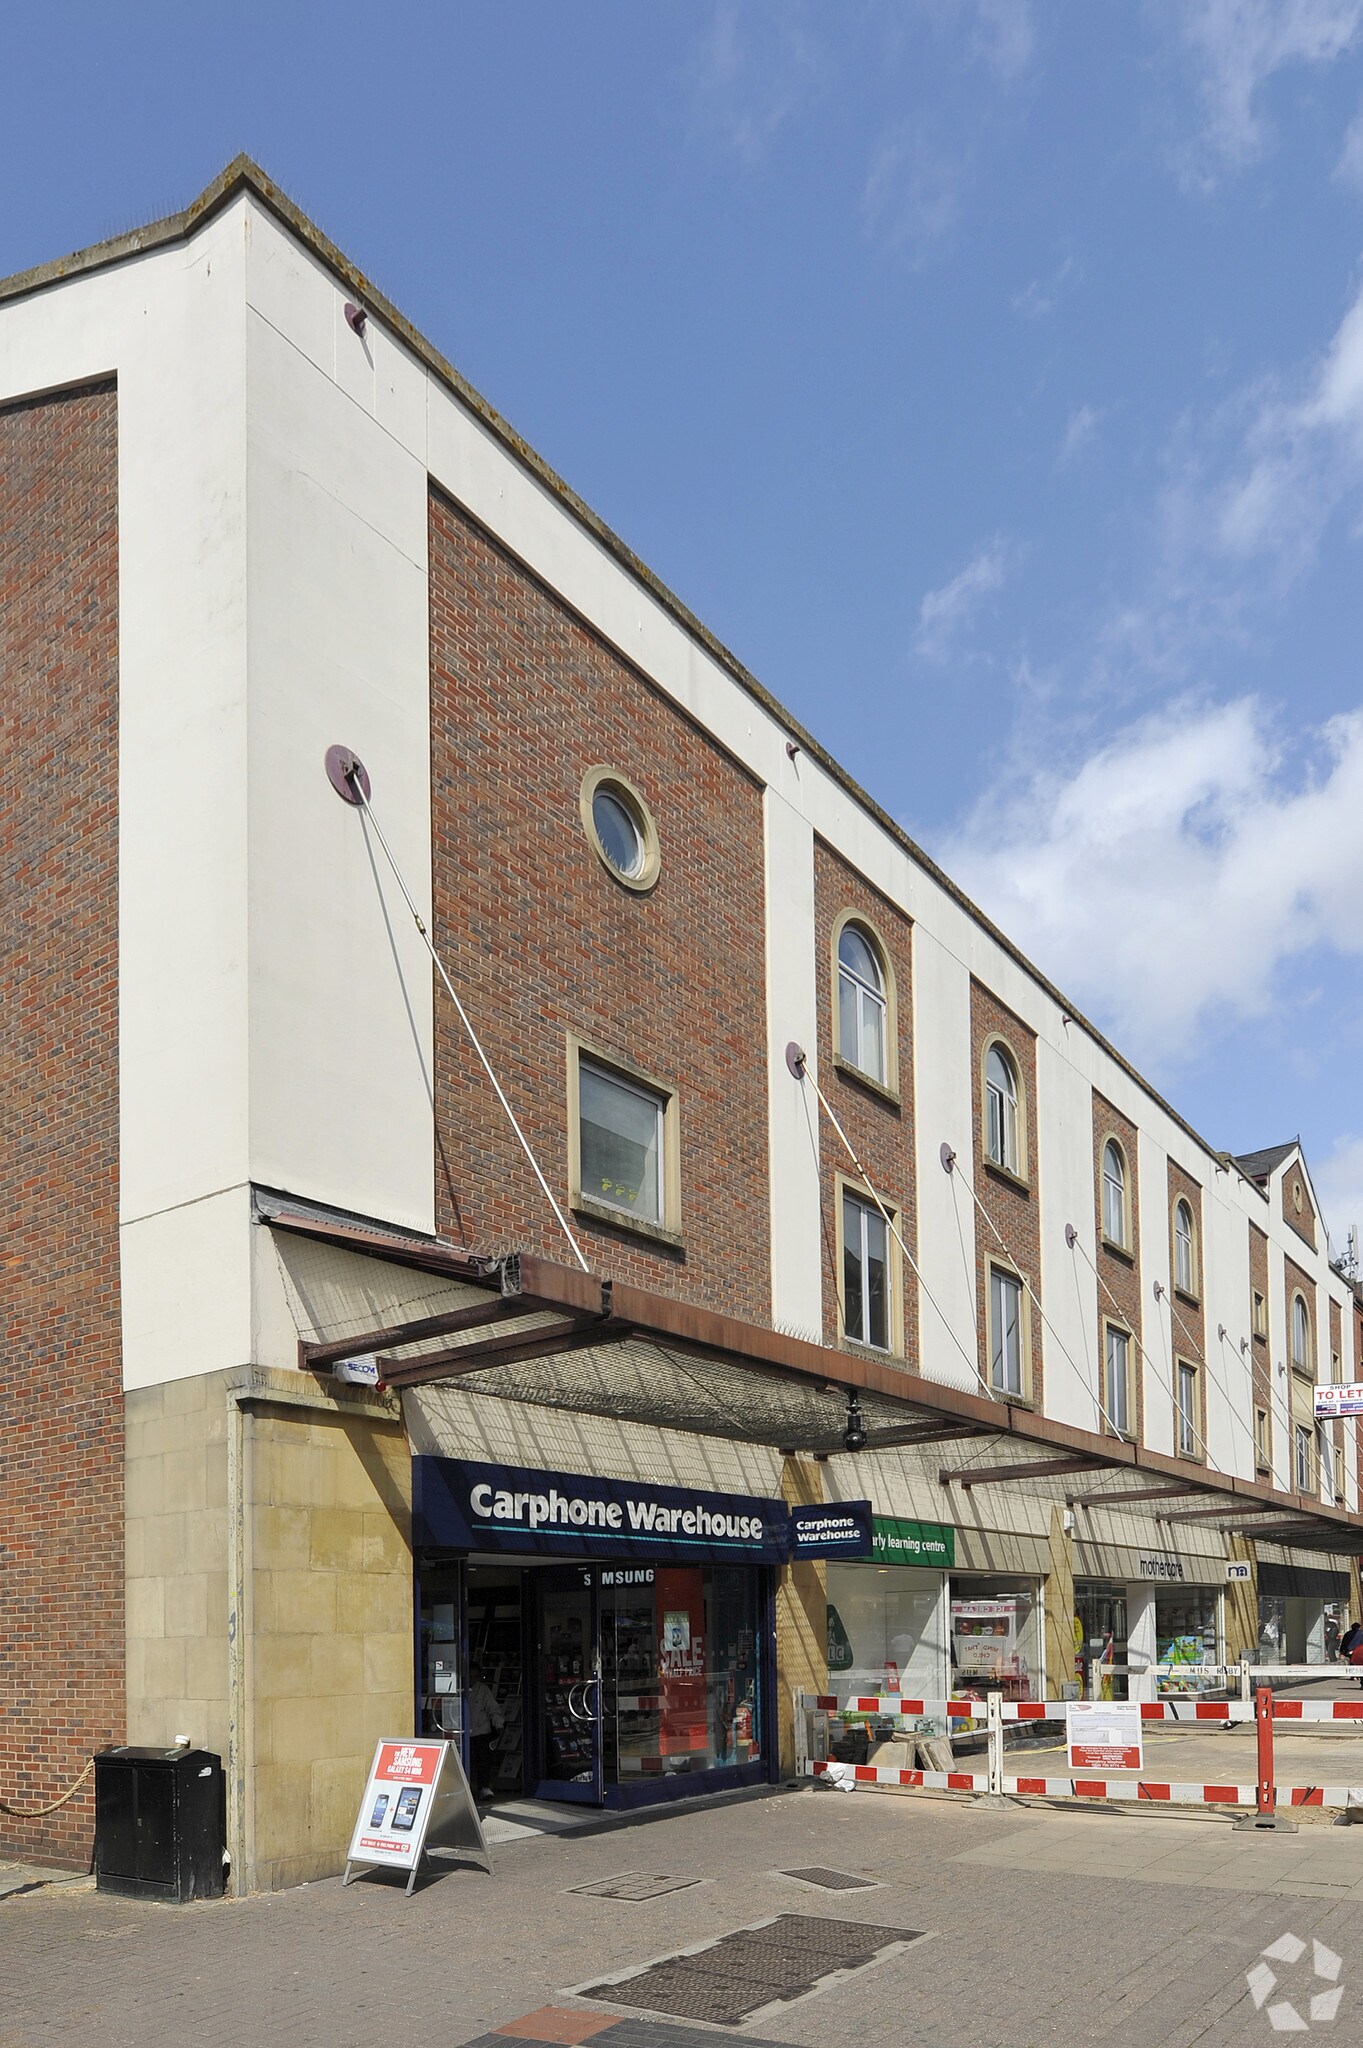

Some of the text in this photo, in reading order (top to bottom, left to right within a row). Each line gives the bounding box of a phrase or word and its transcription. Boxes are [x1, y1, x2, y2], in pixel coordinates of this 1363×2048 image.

[347, 1363, 375, 1374] SECOM
[1316, 1389, 1363, 1400] TO LET
[469, 1483, 763, 1540] Carphone Warehouse
[796, 1517, 855, 1532] Carphone
[796, 1529, 861, 1542] Warehouse
[872, 1533, 946, 1554] arly learning centre
[1140, 1556, 1183, 1578] mothercare
[583, 1569, 655, 1586] SMSUNG
[660, 1636, 704, 1668] SALE
[828, 1646, 844, 1660] LC
[400, 1747, 416, 1758] NEW
[393, 1756, 423, 1768] SAMSUNG
